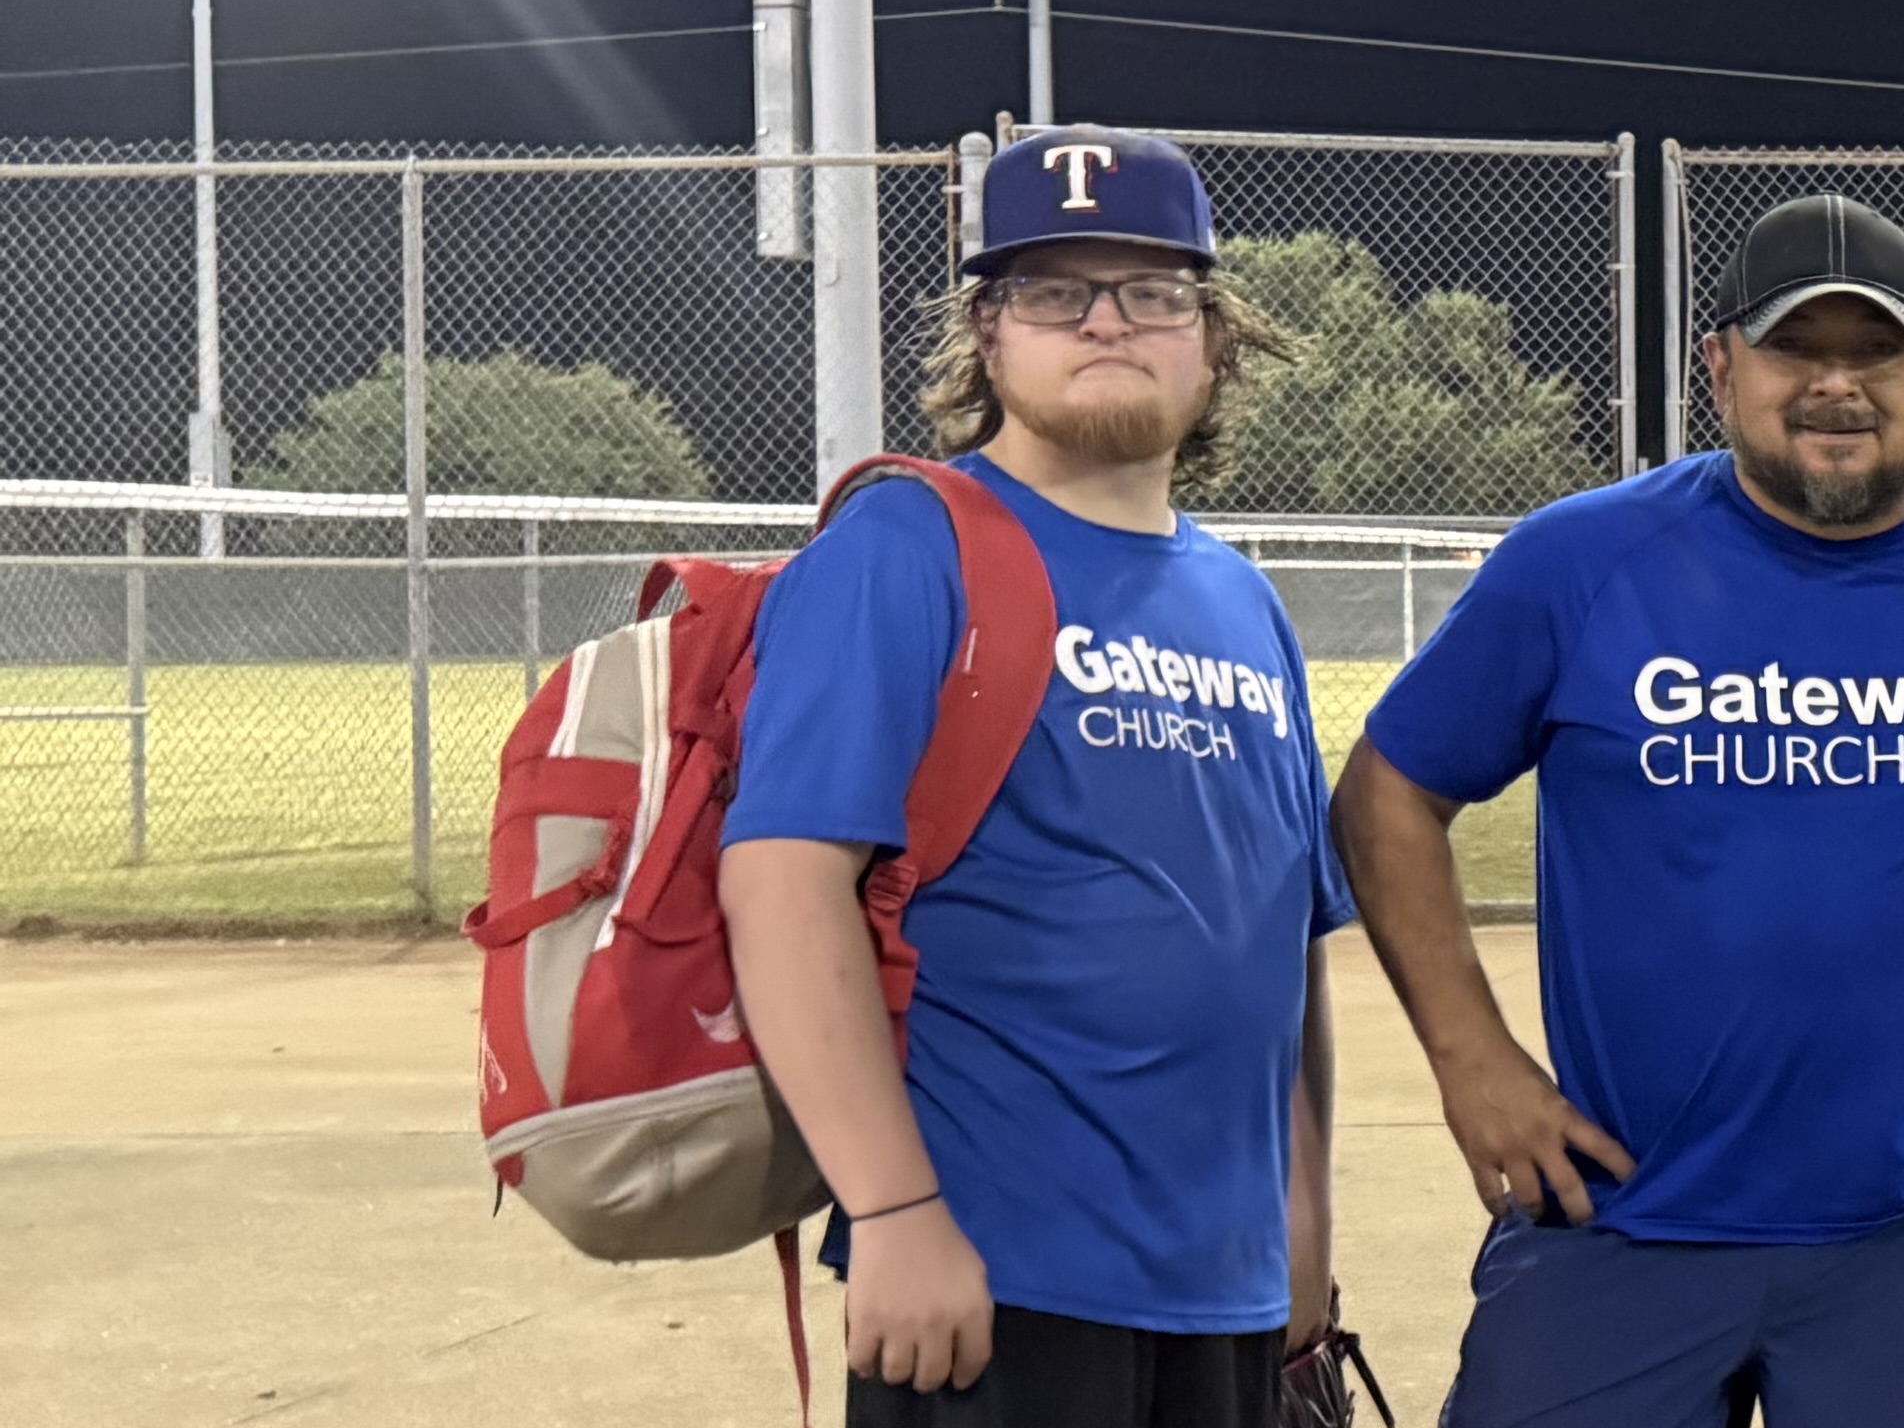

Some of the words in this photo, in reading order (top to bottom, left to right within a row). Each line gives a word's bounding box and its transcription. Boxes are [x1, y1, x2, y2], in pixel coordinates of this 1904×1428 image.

[1043, 144, 1118, 212] T
[1054, 624, 1289, 738] Gateway
[1077, 705, 1236, 761] CHURCH
